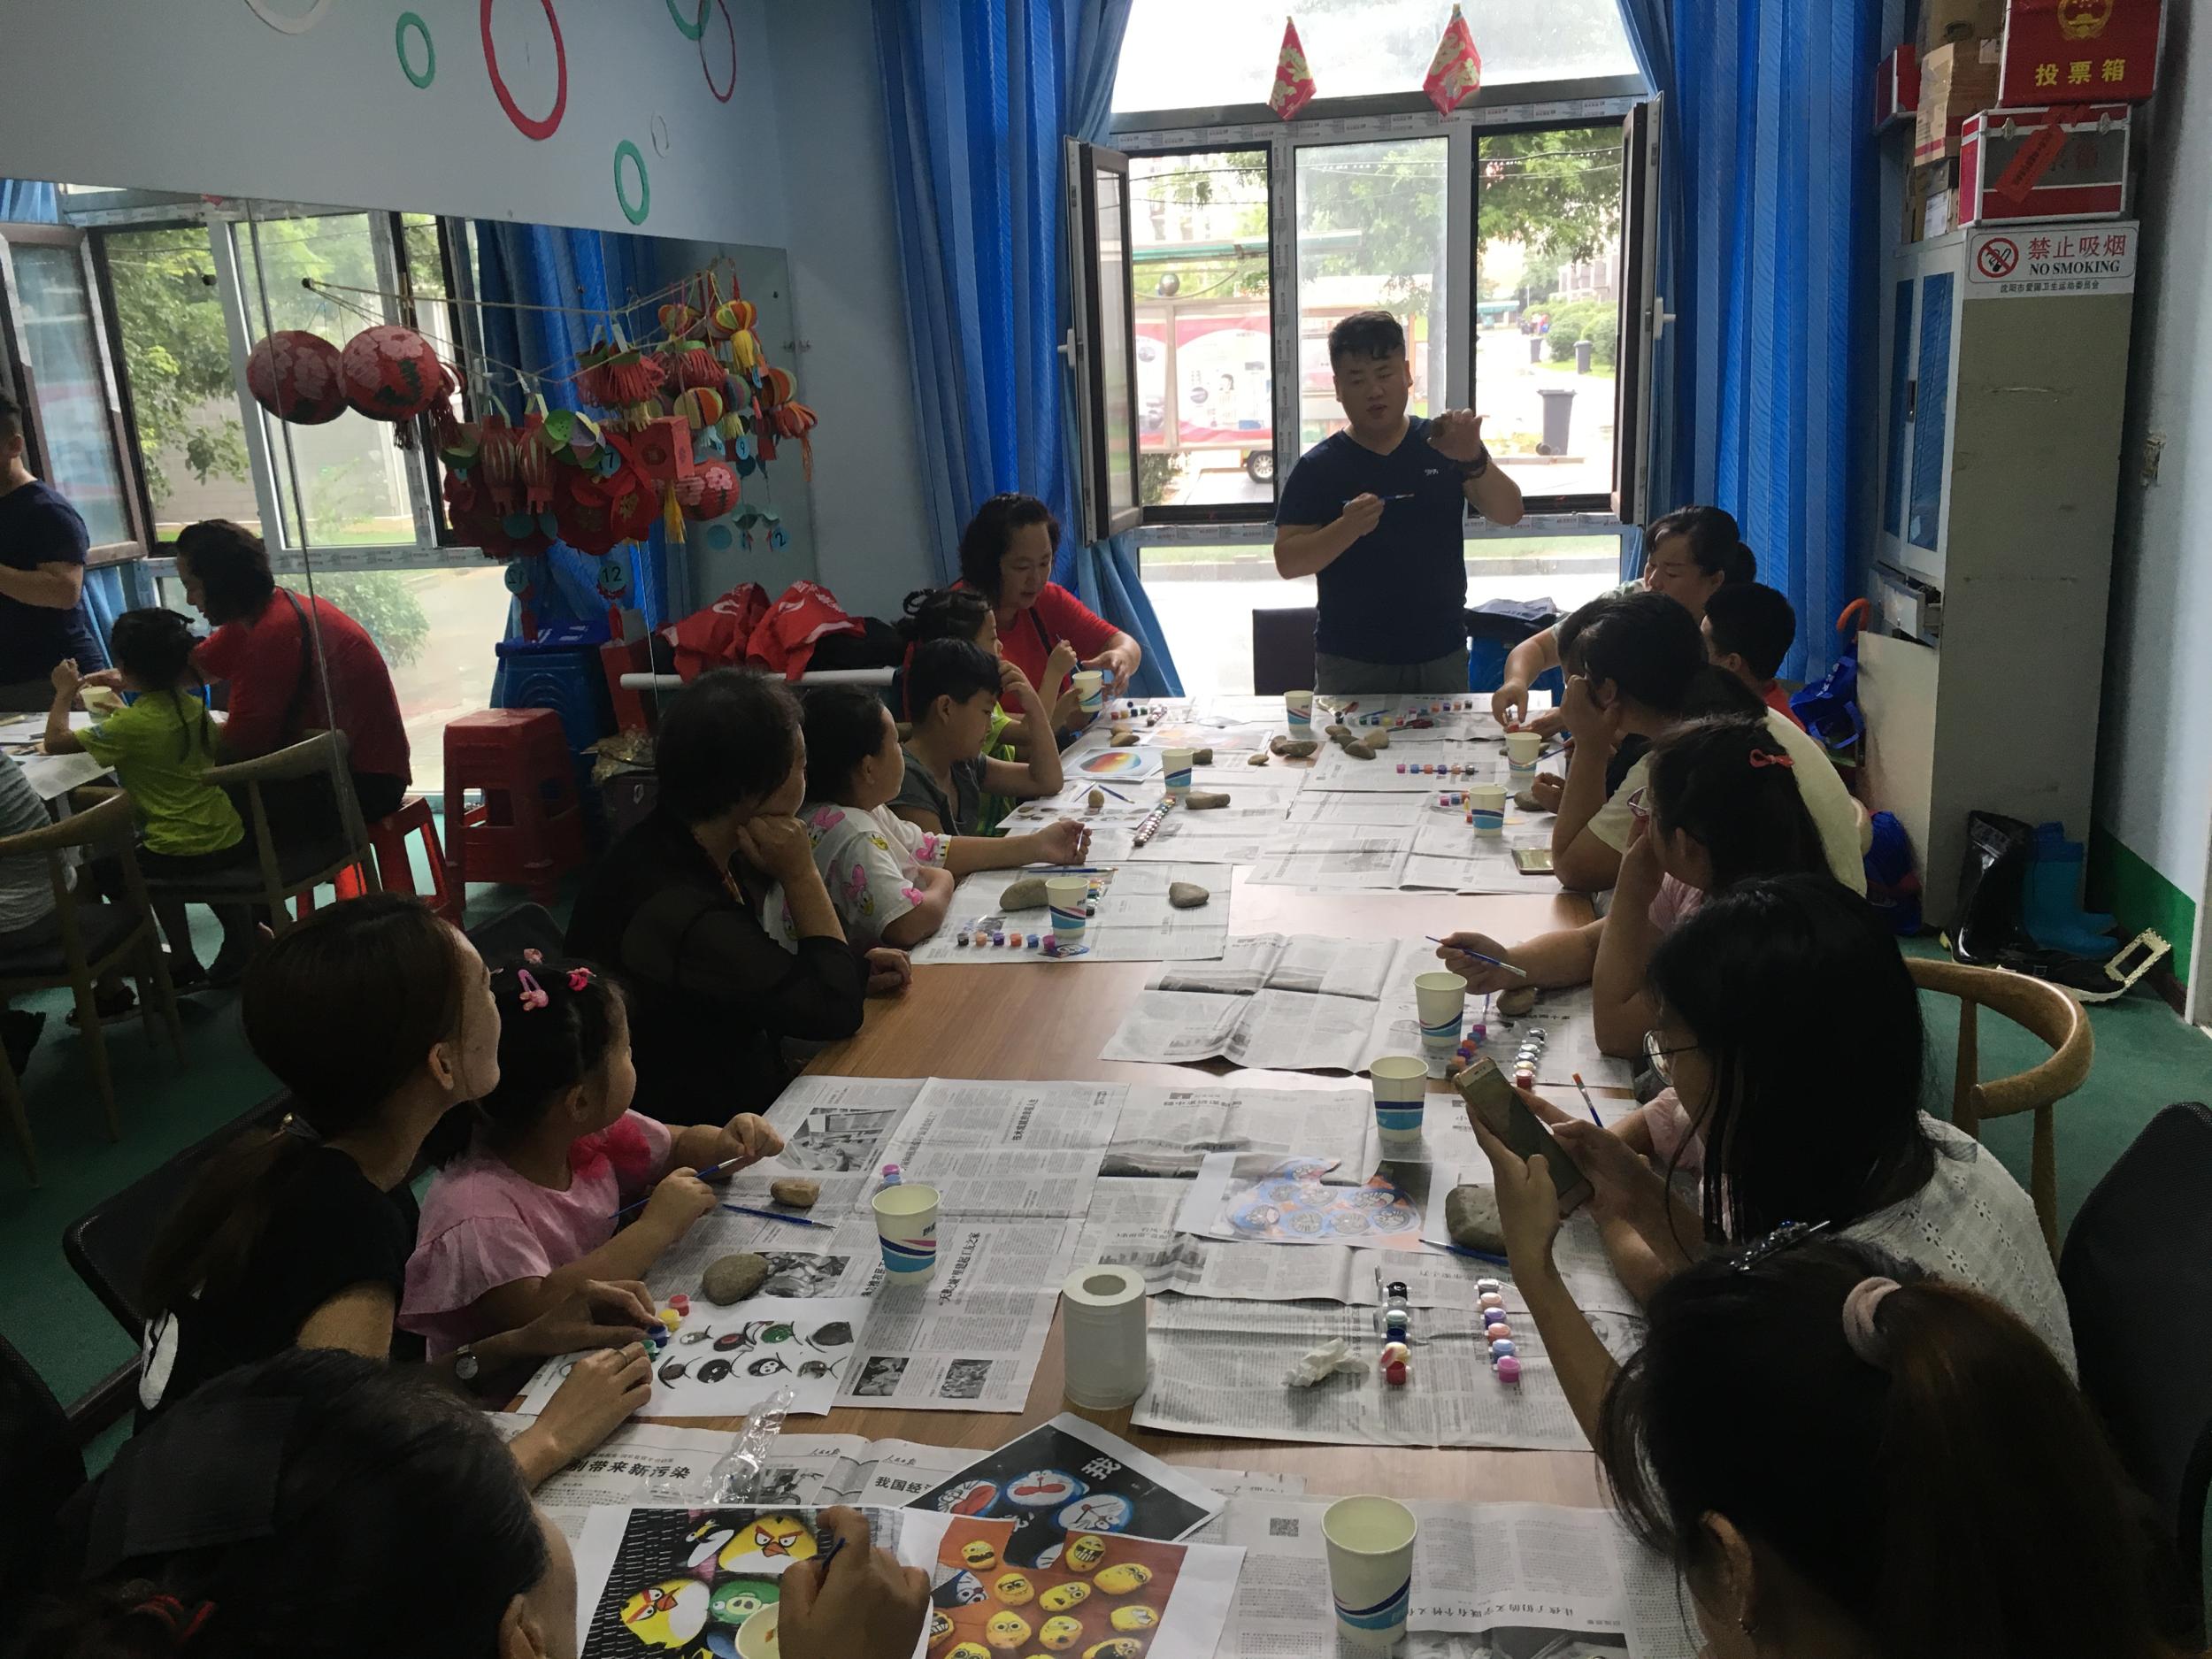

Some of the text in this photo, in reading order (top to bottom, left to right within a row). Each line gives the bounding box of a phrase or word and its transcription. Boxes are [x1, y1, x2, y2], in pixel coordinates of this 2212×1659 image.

[2035, 58, 2126, 87] 投票箱
[2028, 234, 2126, 260] 禁止吸烟
[2030, 259, 2120, 275] NO SMOKING
[774, 533, 786, 547] 2
[602, 565, 622, 583] 12
